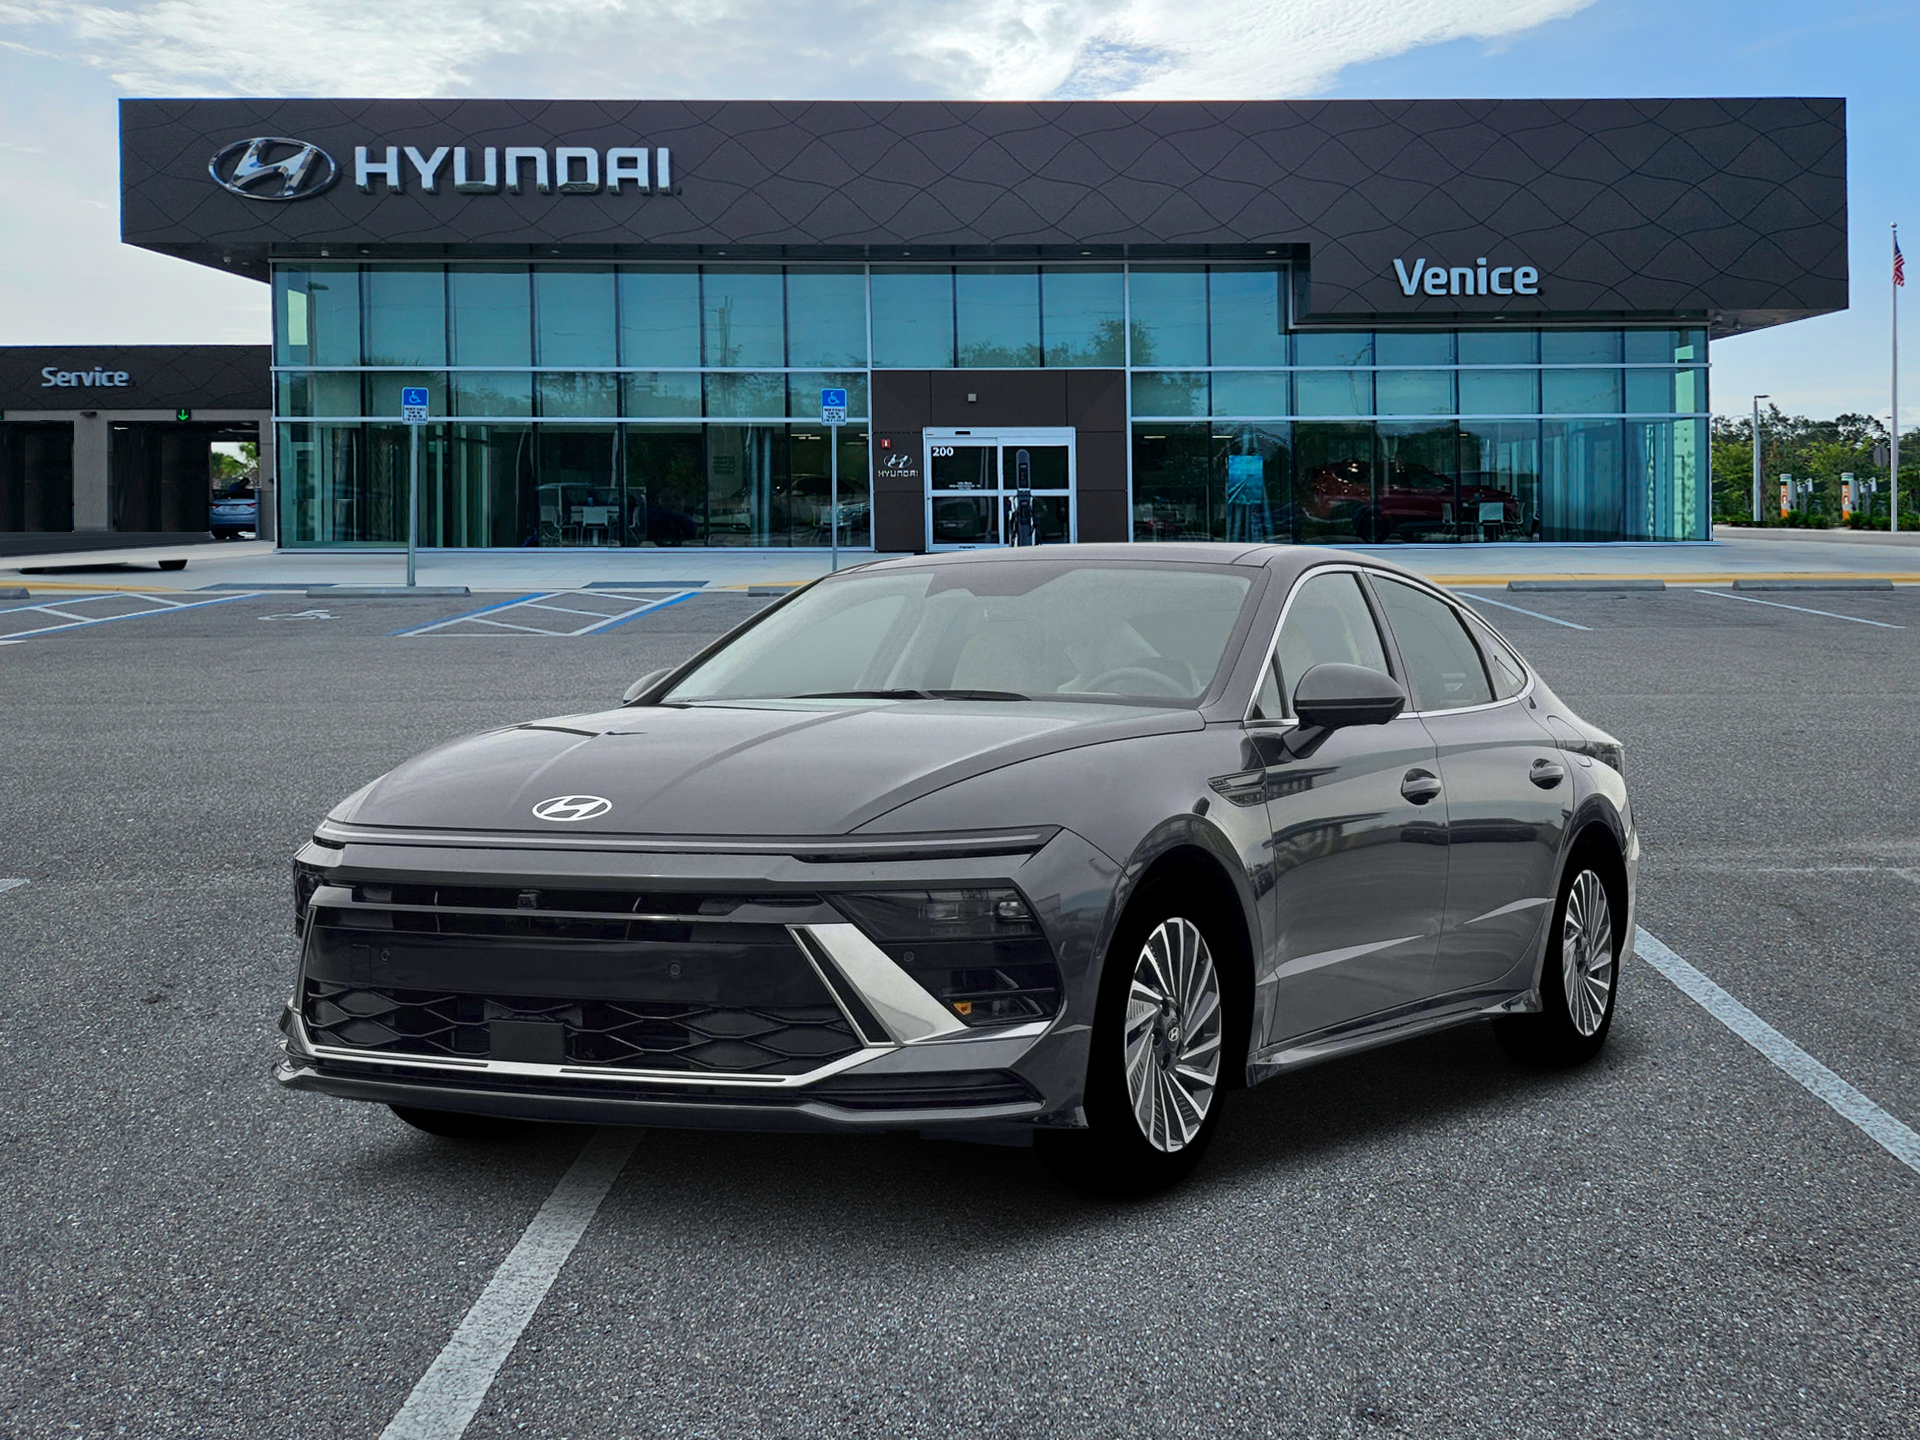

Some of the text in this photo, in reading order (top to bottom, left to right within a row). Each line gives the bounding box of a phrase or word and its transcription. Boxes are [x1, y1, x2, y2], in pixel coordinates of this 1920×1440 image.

[354, 145, 671, 194] HYUNDAI
[1392, 256, 1539, 296] Venice
[41, 366, 130, 388] Service
[932, 446, 955, 457] 200
[877, 469, 919, 478] HYUNDAI
